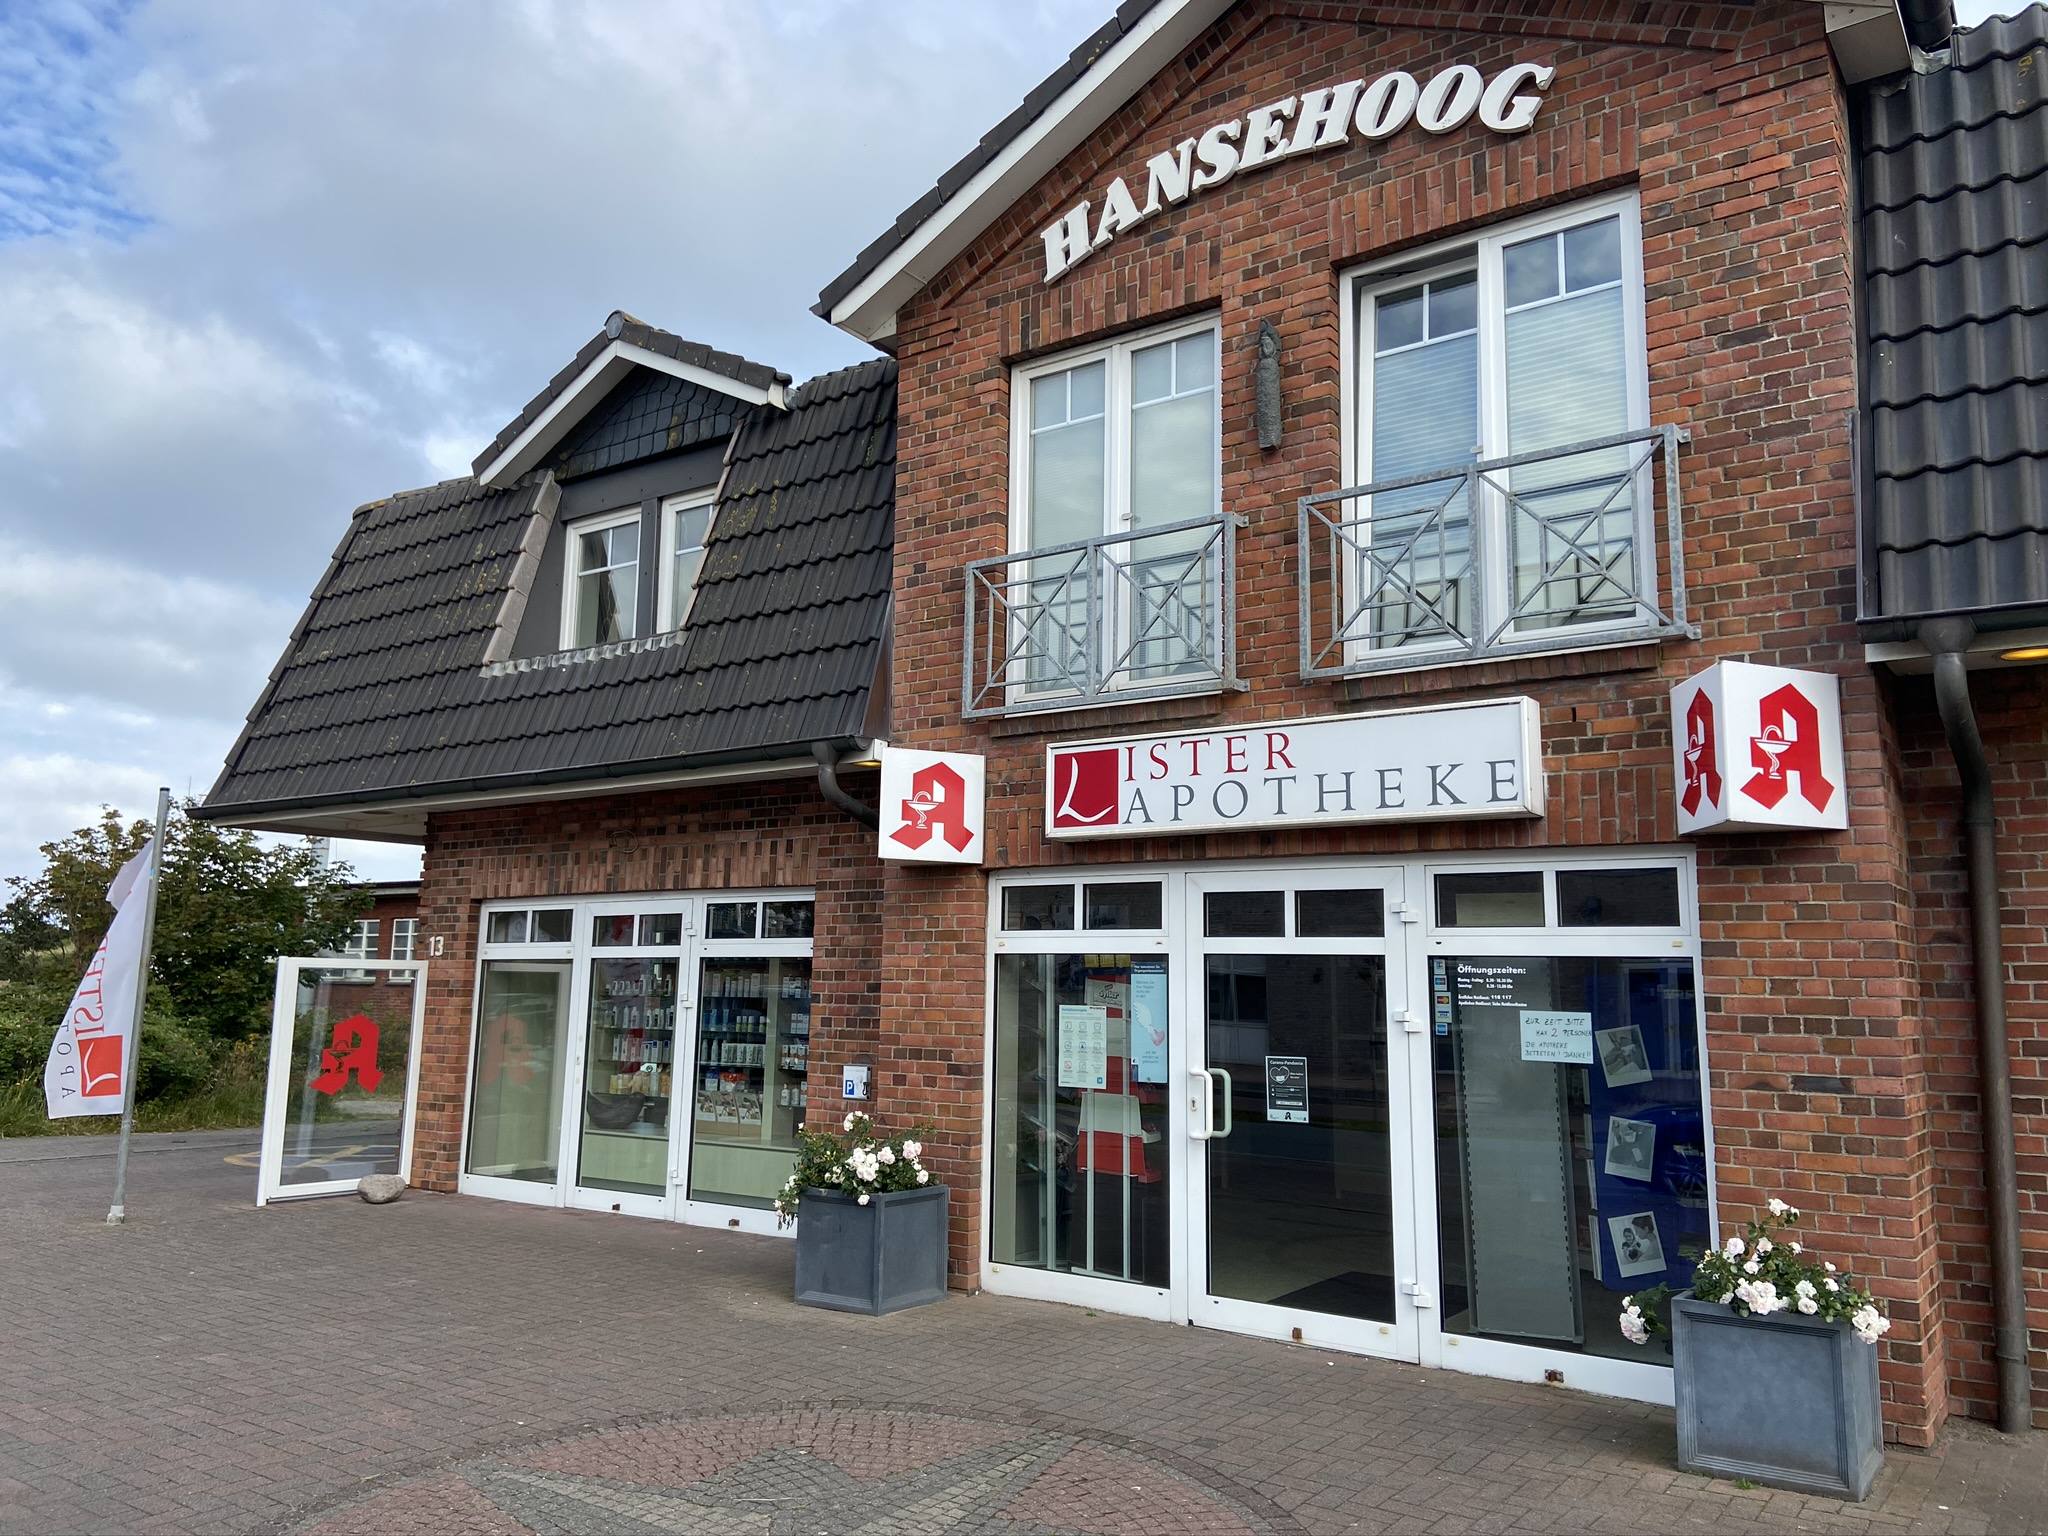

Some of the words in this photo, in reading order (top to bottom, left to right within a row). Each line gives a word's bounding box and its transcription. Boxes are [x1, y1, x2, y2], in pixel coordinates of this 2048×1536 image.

[1040, 63, 1557, 285] HANSEHOOG
[1123, 759, 1519, 825] APOTHEKE
[430, 936, 444, 956] 13
[1457, 963, 1527, 976] Öffnungszeiten:
[1551, 1028, 1558, 1037] 2
[846, 1081, 853, 1094] P
